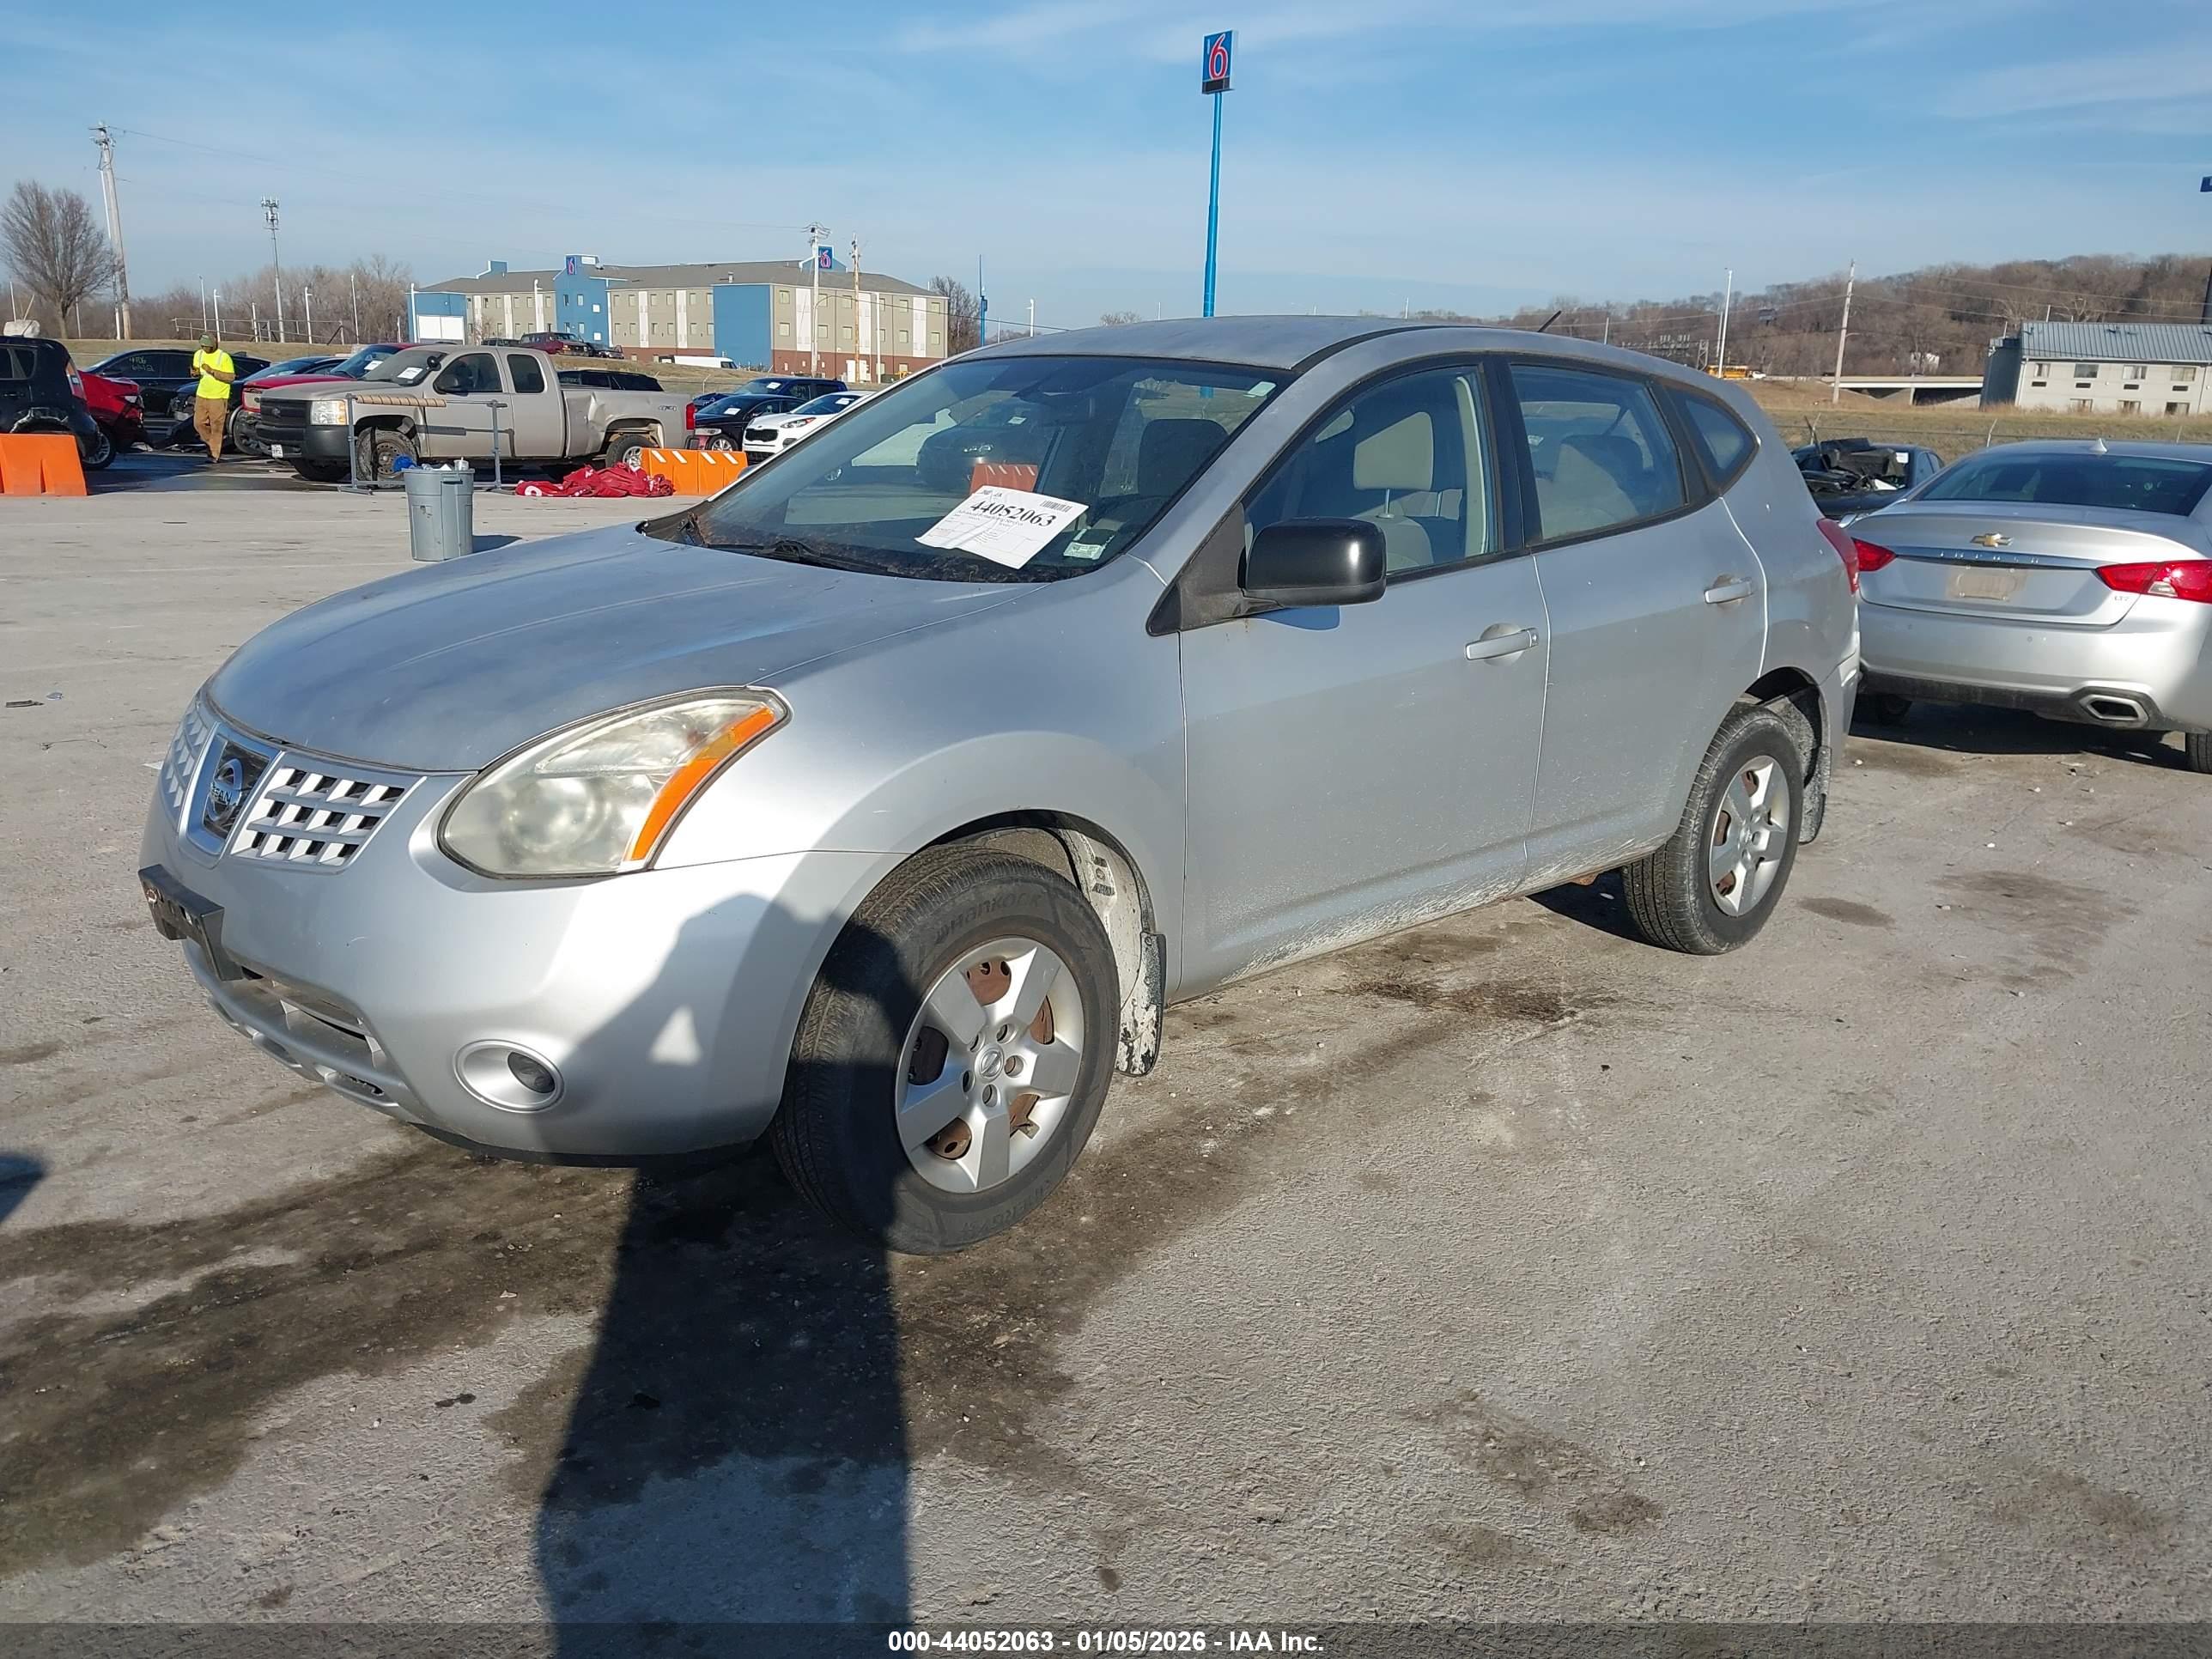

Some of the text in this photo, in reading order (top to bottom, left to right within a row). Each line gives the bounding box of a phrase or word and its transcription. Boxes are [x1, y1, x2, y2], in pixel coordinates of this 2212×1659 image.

[1209, 33, 1228, 80] 6
[821, 250, 831, 268] 6
[969, 501, 1057, 527] 44052063
